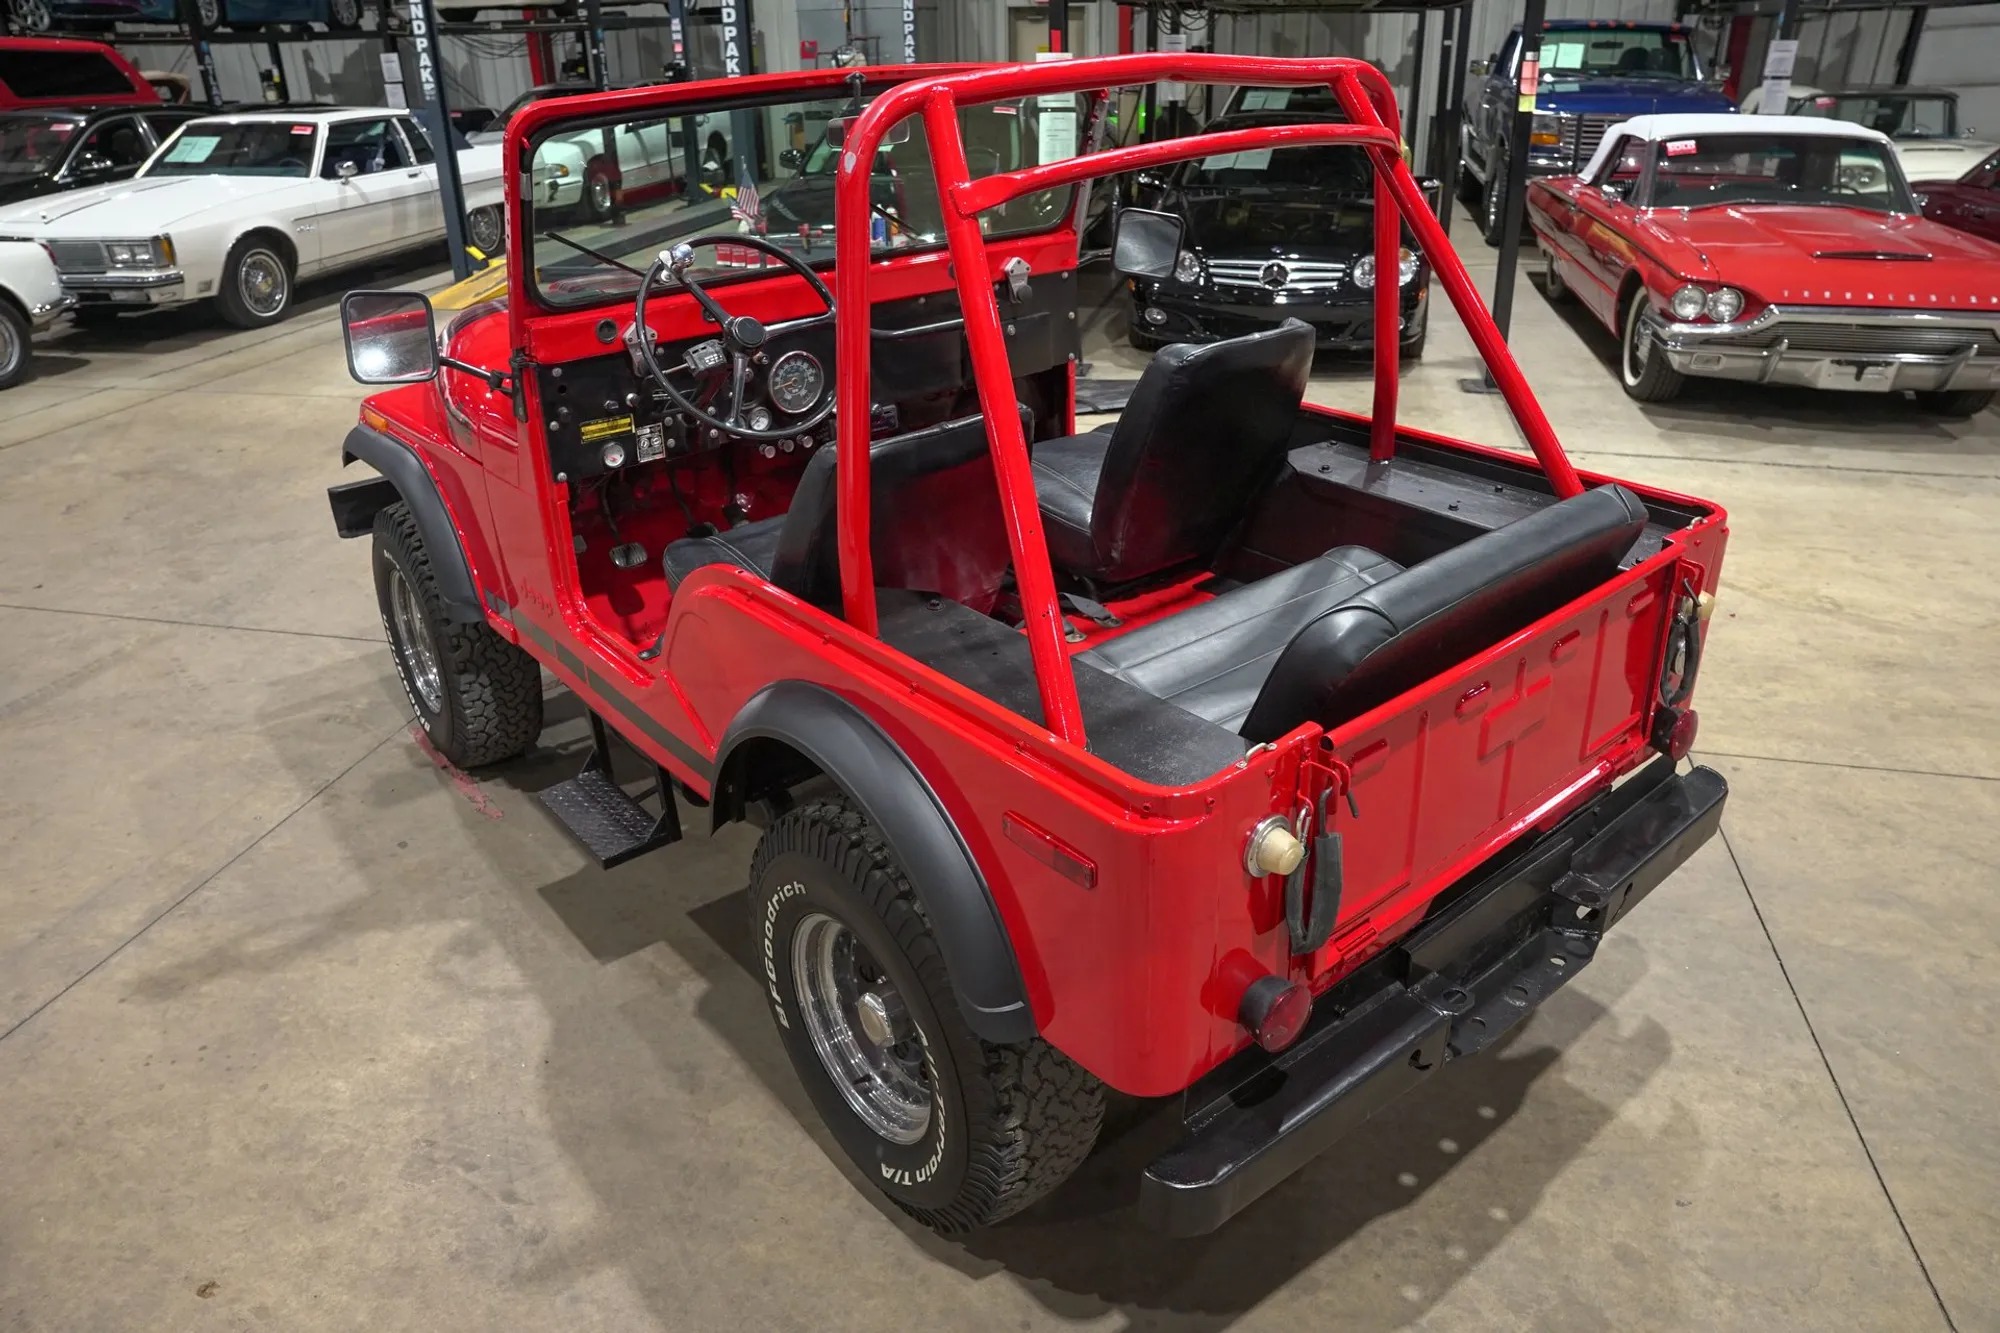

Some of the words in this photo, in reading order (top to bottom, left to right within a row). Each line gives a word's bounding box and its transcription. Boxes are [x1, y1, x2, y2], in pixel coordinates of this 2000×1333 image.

[409, 0, 434, 82] NDPAK
[764, 881, 806, 1029] BFGoodrich
[881, 1162, 912, 1186] T/A
